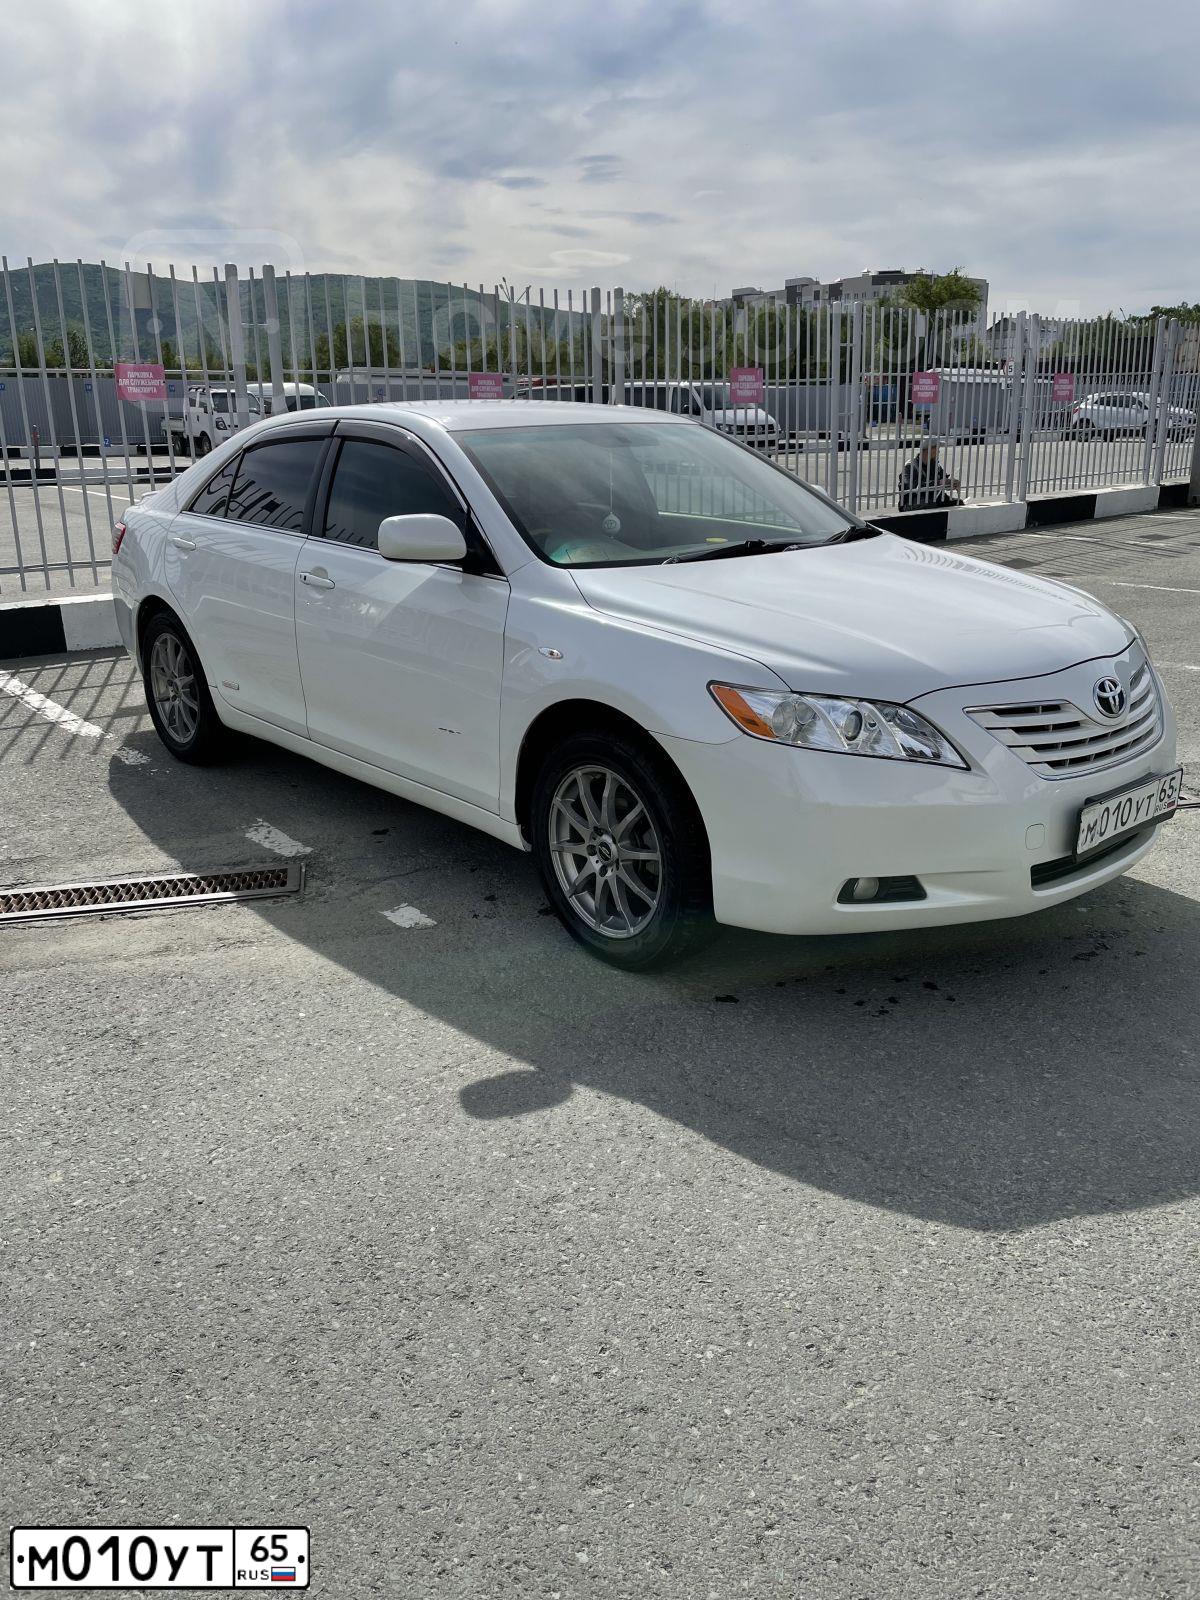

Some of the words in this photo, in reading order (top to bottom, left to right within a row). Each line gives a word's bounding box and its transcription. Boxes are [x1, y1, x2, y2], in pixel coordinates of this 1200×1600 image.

[1081, 793, 1155, 846] М010УТ
[1158, 776, 1176, 802] 65
[1155, 801, 1168, 814] RUS
